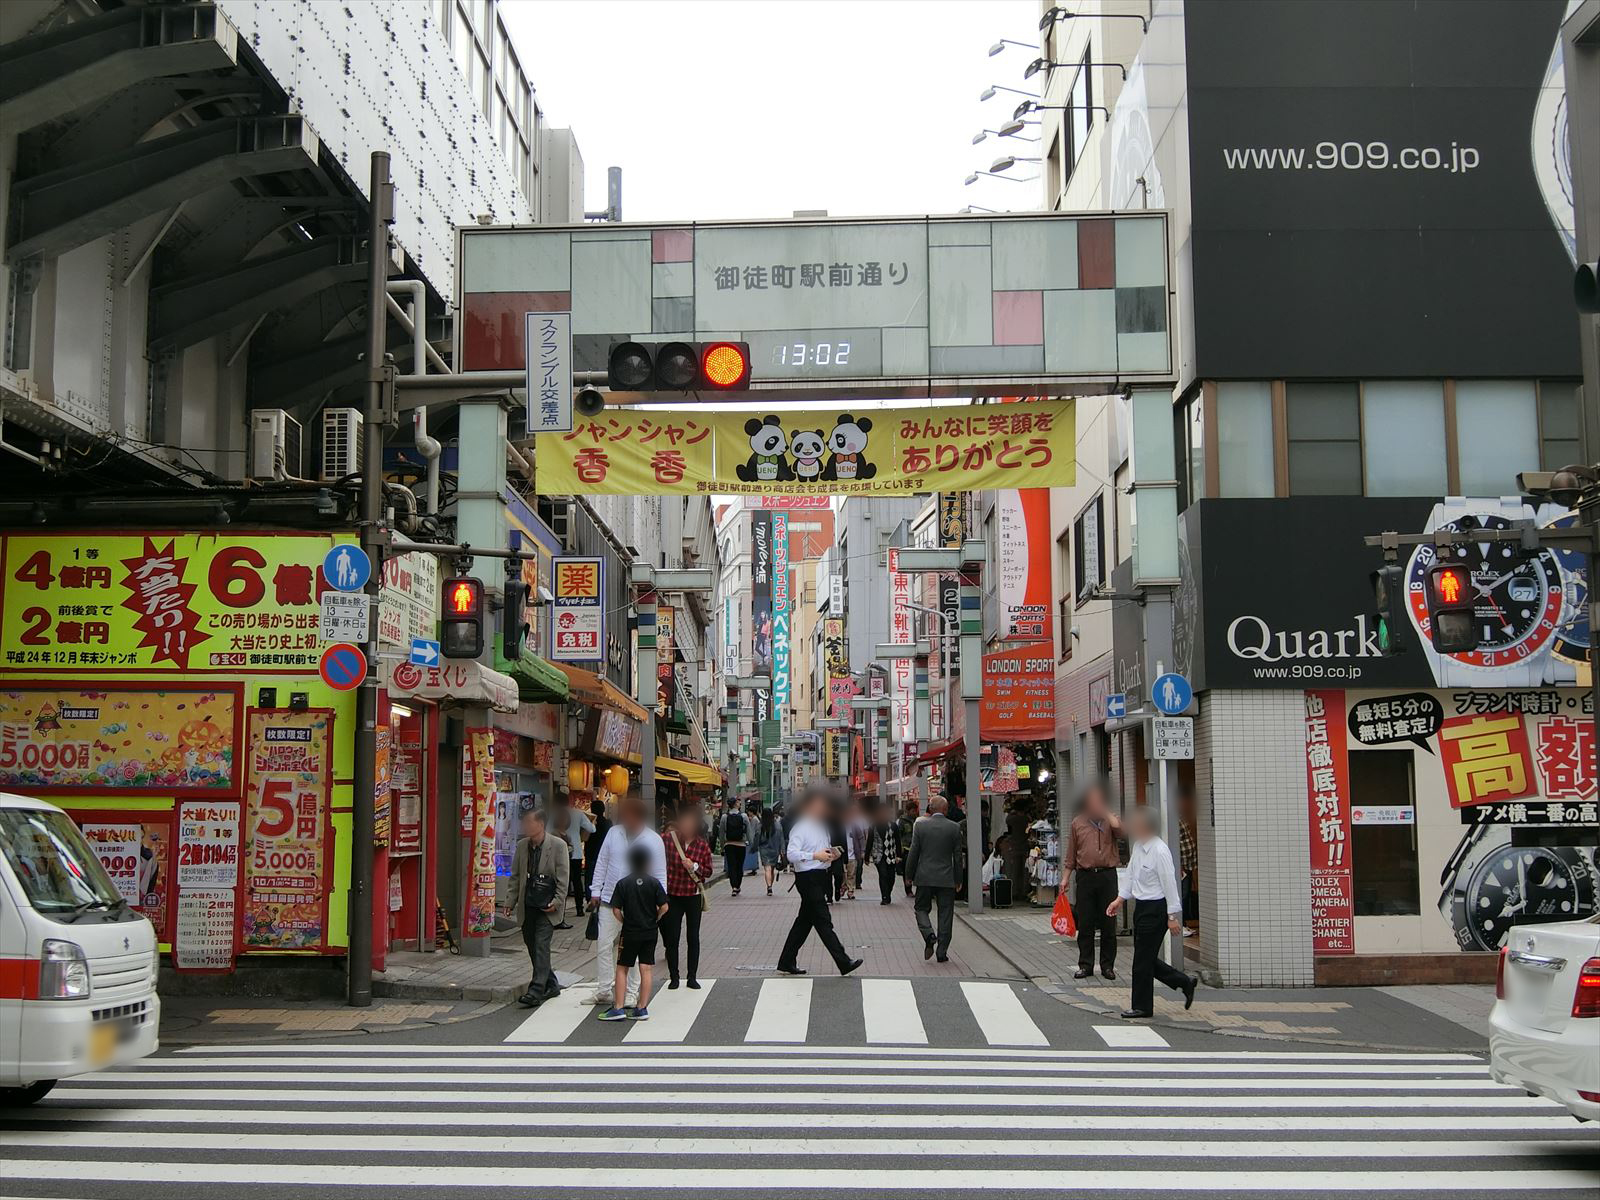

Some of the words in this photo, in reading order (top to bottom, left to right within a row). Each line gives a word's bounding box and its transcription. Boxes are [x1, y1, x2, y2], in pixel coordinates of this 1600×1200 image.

[1223, 142, 1481, 172] www.909.co.jp
[714, 261, 909, 291] 御徒町駅前通り
[779, 342, 851, 366] 13:02
[540, 319, 560, 426] スクランブル交差点
[900, 412, 1054, 440] みんなに笑顔を
[902, 438, 1053, 474] ありがとう
[573, 447, 610, 483] 香
[650, 450, 687, 483] 香
[14, 550, 112, 591] 4億円
[208, 545, 324, 609] 6億
[562, 564, 593, 596] 薬
[324, 596, 367, 606] 自転車を除く
[1514, 590, 1531, 600] 27
[58, 605, 113, 616] 前後賞で
[326, 606, 336, 616] 13
[357, 608, 364, 617] 6
[1007, 605, 1047, 613] LONDON
[20, 606, 110, 646] 2億円
[325, 628, 335, 638] 12
[356, 630, 363, 640] 6
[562, 632, 593, 647] 免税
[1227, 614, 1383, 662] Quark
[249, 654, 321, 665] 御徒町駅前セ
[986, 659, 1022, 673] LONDON
[427, 665, 468, 688] 宝くじ
[1253, 666, 1362, 680] www.909.co.jp
[1356, 699, 1433, 722] 最短5分の
[266, 729, 311, 740] 枚数限定!
[1157, 729, 1166, 738] 13
[1183, 729, 1189, 738] 6
[1359, 716, 1435, 742] 無料査定!
[1158, 748, 1166, 757] 12
[1184, 748, 1190, 757] 6
[182, 807, 237, 821] 大当たり!!
[1476, 803, 1598, 823] アメ横一番の高
[1312, 918, 1350, 927] CARTIER
[1312, 928, 1348, 938] CHANEL
